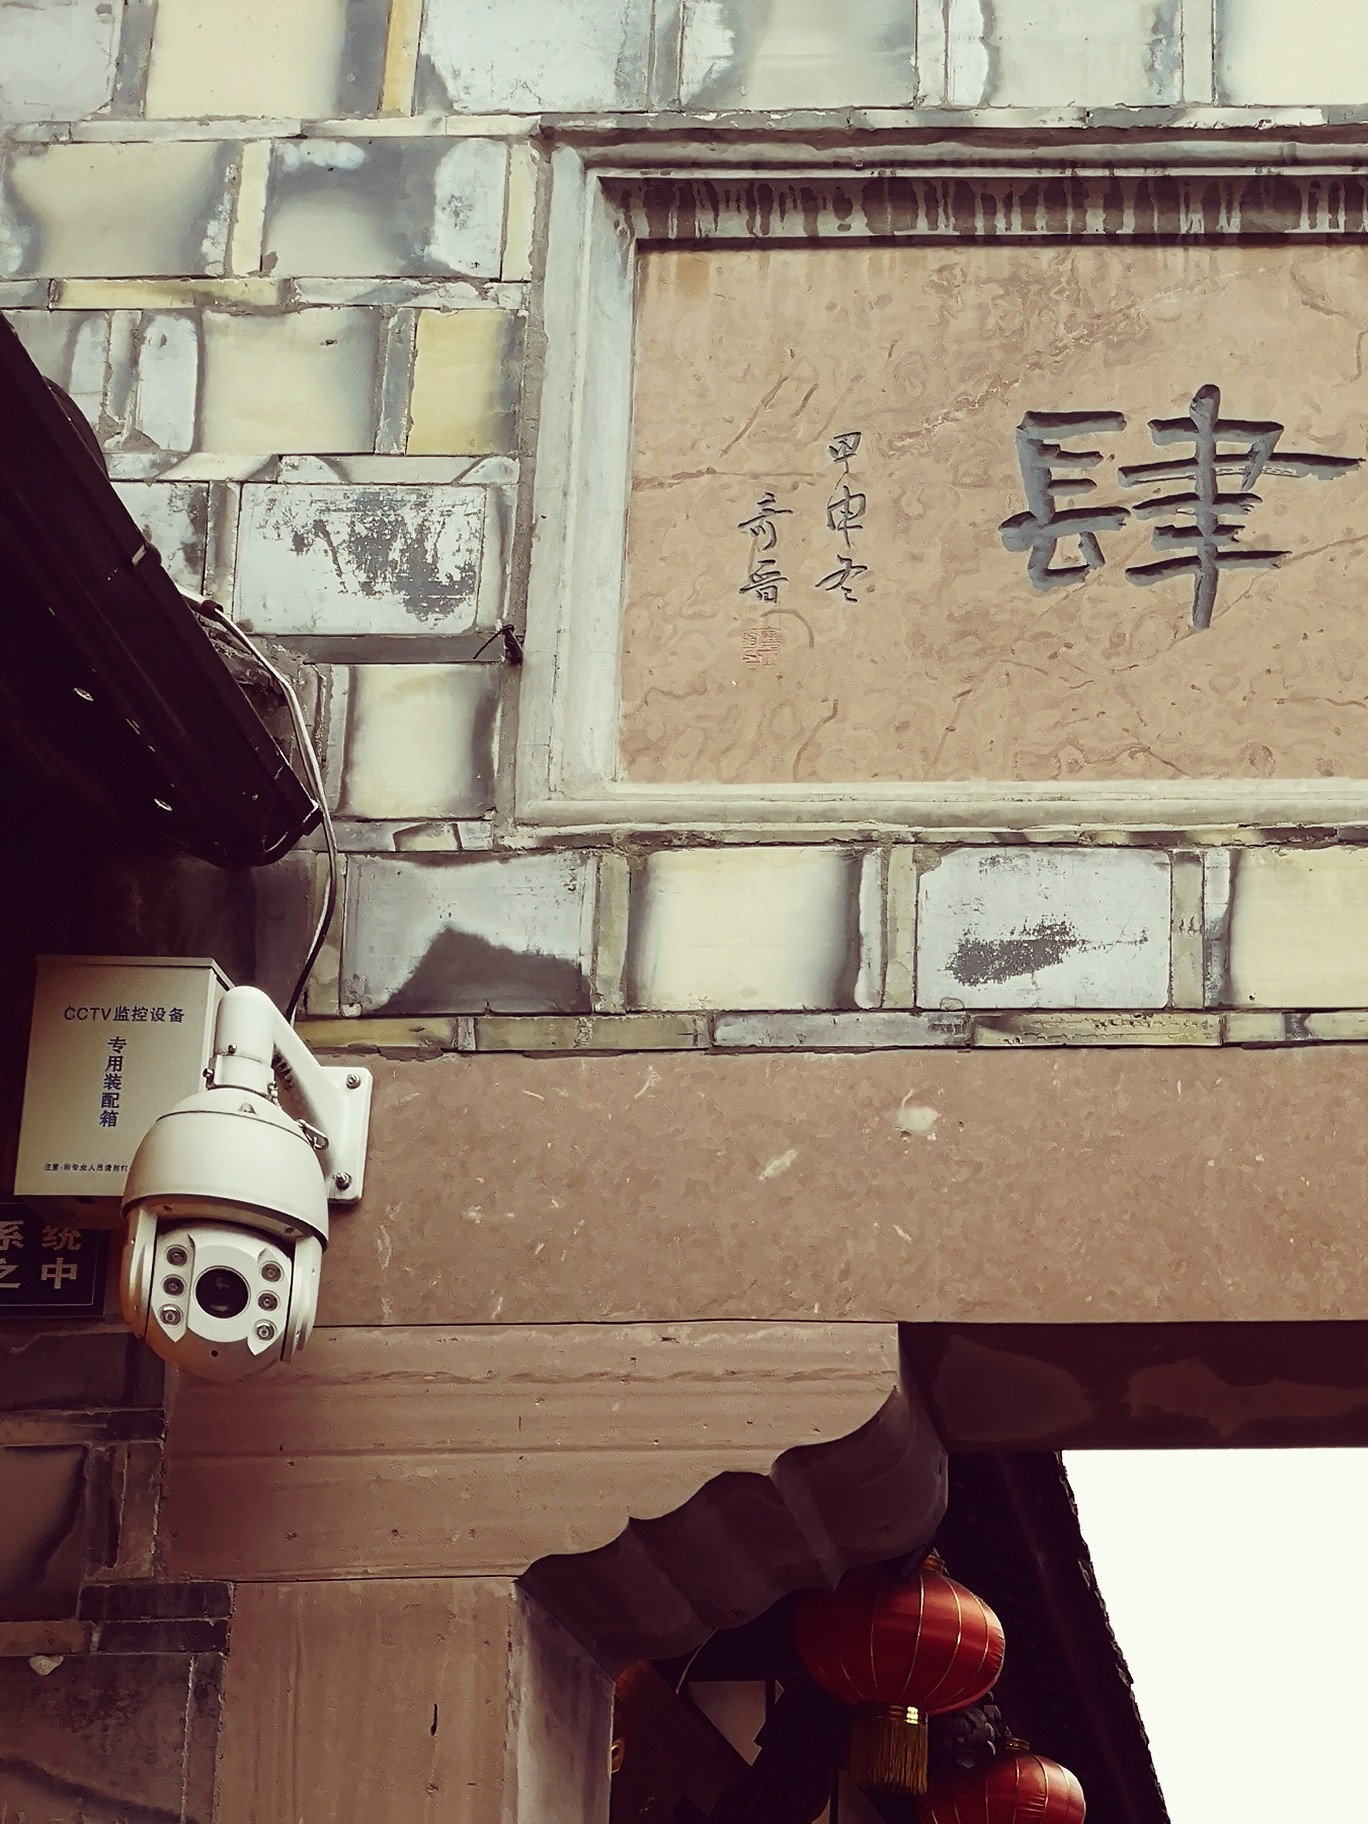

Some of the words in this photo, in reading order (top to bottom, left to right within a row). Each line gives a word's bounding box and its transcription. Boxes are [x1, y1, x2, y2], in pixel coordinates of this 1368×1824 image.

[63, 1005, 185, 1024] CCTV监控设备
[98, 1036, 127, 1128] 专用装配箱
